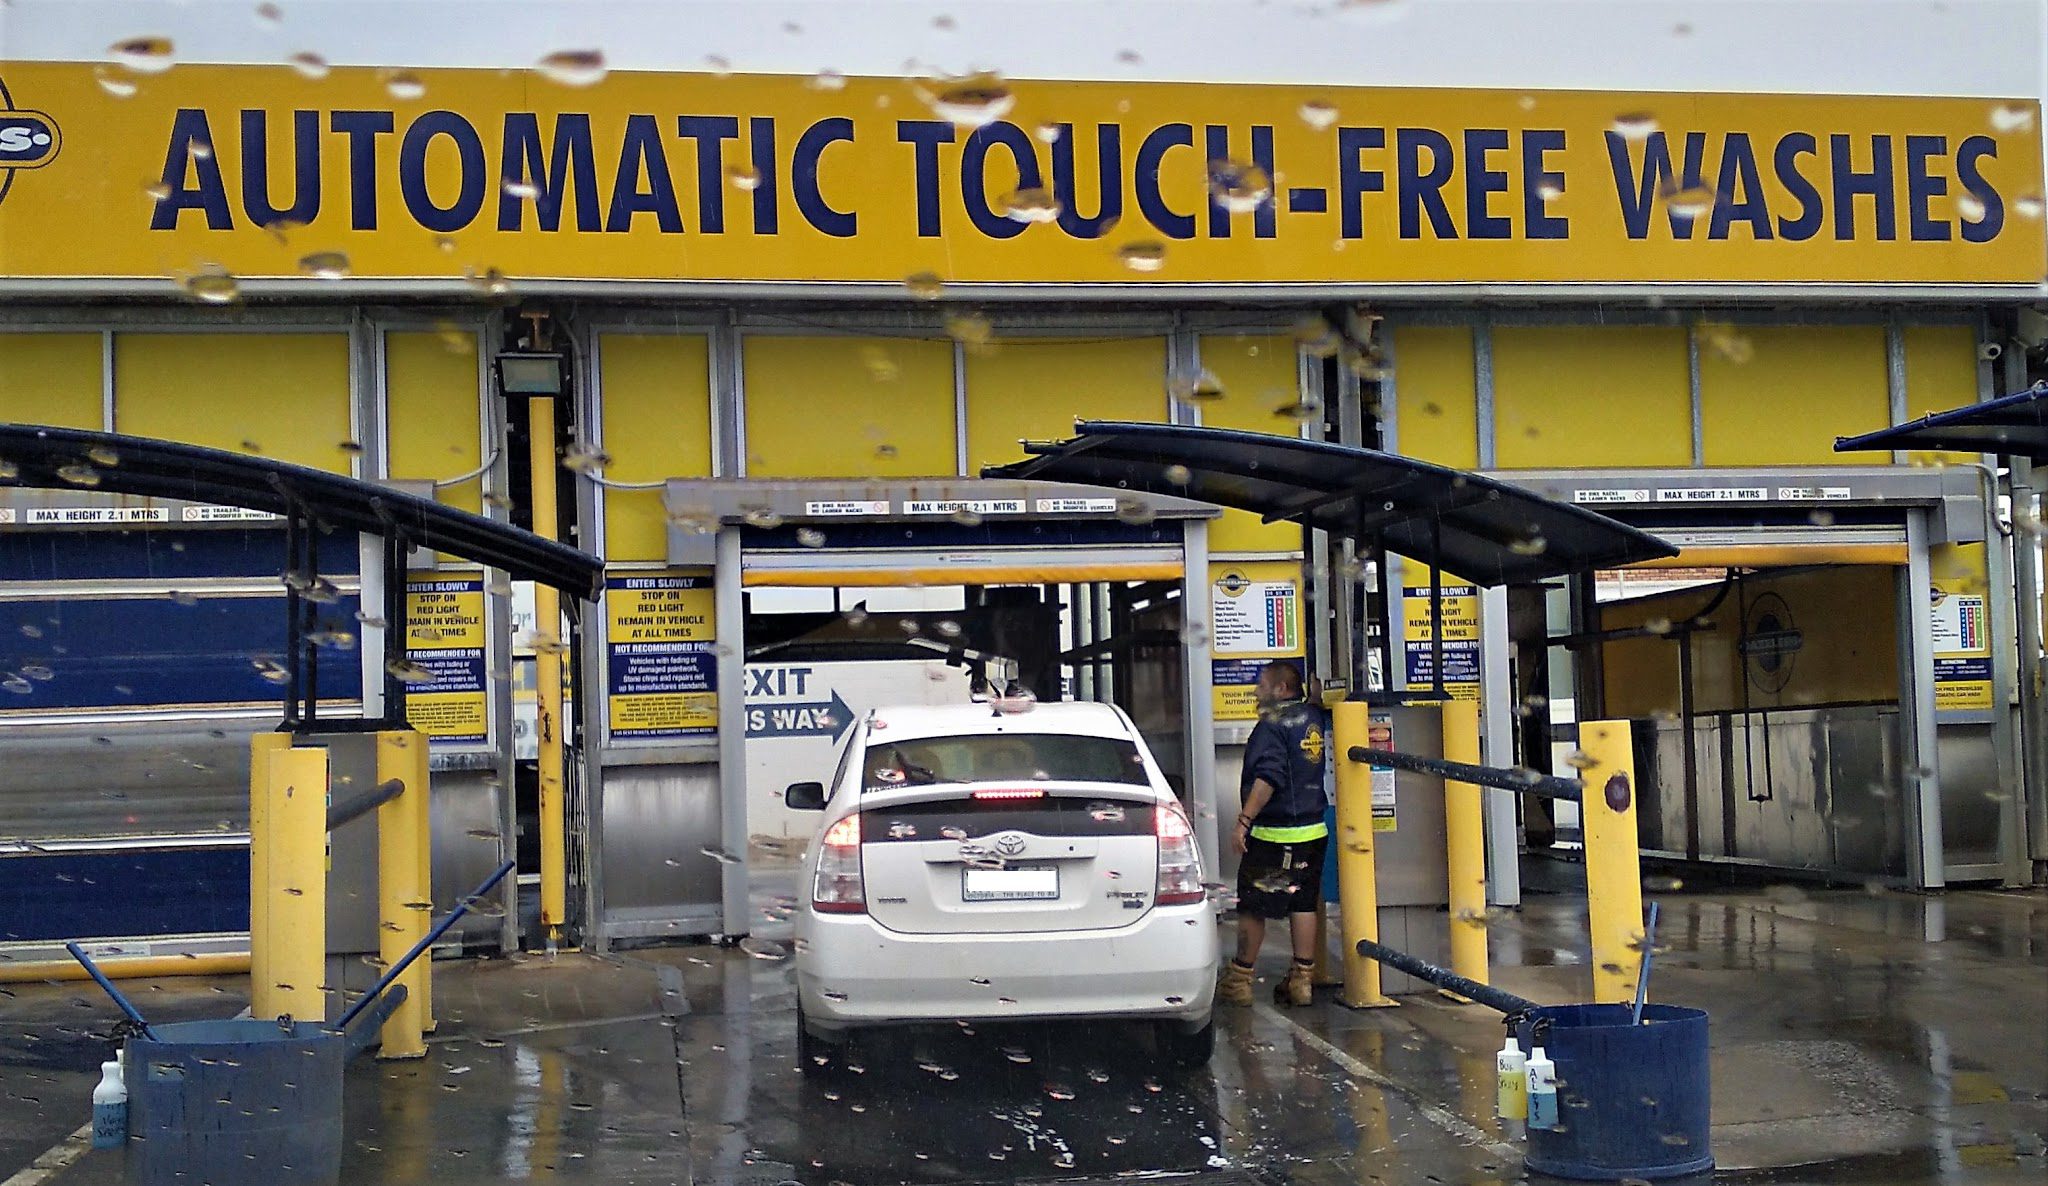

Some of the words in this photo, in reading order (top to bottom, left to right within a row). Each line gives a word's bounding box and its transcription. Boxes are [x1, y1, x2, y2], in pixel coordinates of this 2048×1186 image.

[150, 107, 858, 238] AUTOMATIC
[897, 120, 1569, 242] TOUCH-FREE
[1604, 129, 2005, 243] WASHES
[912, 504, 931, 512] MAX
[937, 503, 968, 512] HEIGHT
[973, 503, 987, 512] 2.1
[993, 502, 1018, 511] MTRS
[36, 511, 60, 520] MAX
[66, 510, 102, 520] HEIGHT
[108, 510, 124, 520] 2.1
[131, 510, 160, 520] MTRS
[436, 582, 469, 591] SLOWLY
[626, 579, 655, 588] ENTER
[658, 579, 694, 588] SLOWLY
[1440, 587, 1469, 595] SLOWLY
[420, 595, 441, 603] STOP
[642, 592, 664, 600] STOP
[638, 604, 655, 612] RED
[660, 604, 684, 612] LIGHT
[618, 617, 653, 625] REMAIN
[668, 616, 704, 624] VEHICLE
[632, 630, 642, 638] AT
[645, 629, 661, 637] ALL
[664, 628, 691, 637] TIMES
[615, 645, 631, 653] NOT
[632, 643, 692, 653] RECOMMENDED
[694, 643, 706, 652] FO
[414, 650, 466, 658] RECOMMENDED
[772, 708, 830, 730] WAY
